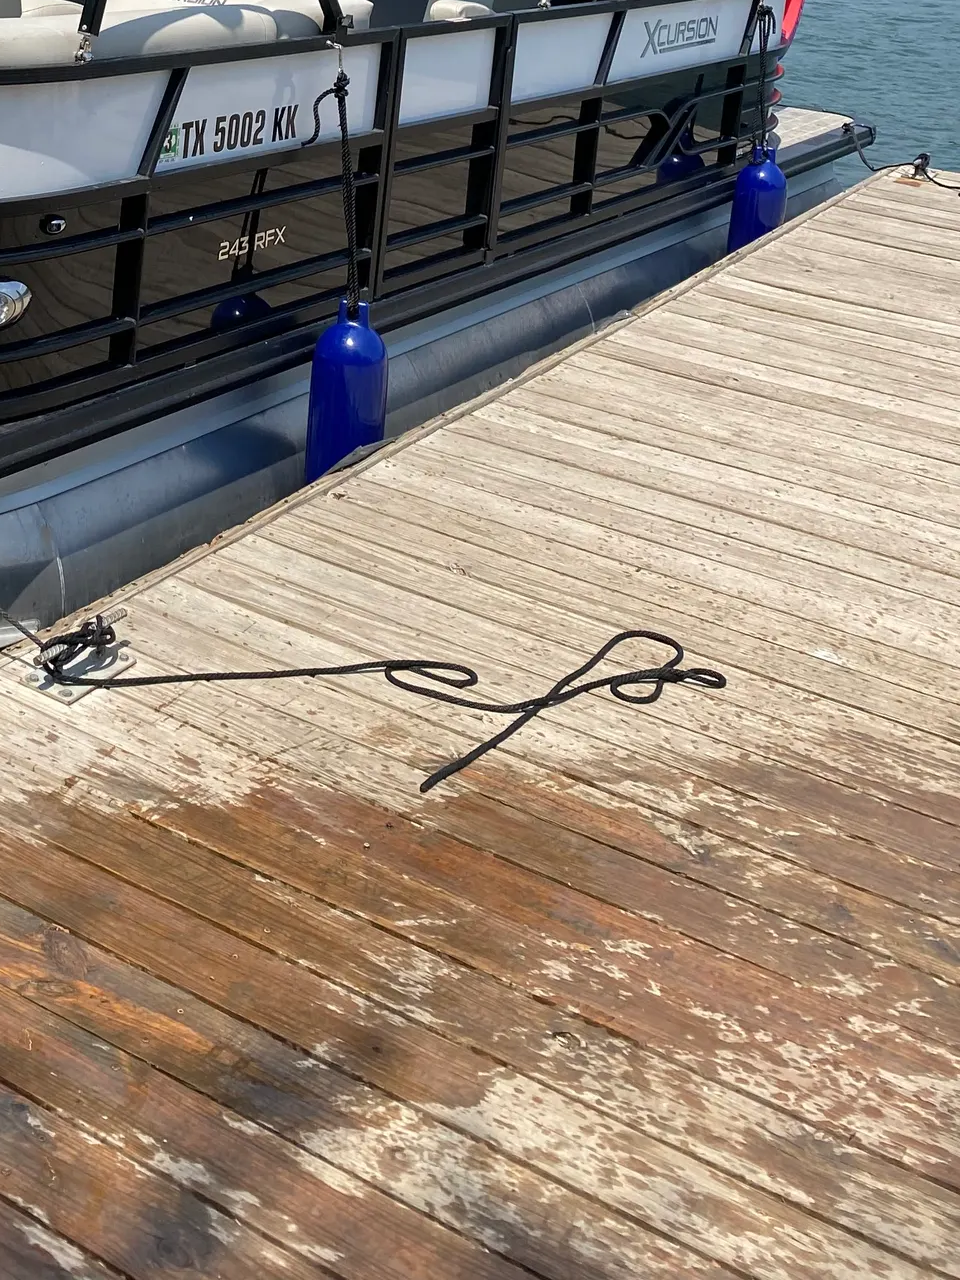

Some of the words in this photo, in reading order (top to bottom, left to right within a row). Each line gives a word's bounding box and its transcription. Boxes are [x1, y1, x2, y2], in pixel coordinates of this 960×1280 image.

[640, 15, 719, 59] XCURSION
[181, 118, 208, 160] TX
[213, 109, 267, 153] 5002
[271, 104, 300, 143] KK
[218, 235, 250, 261] 243
[253, 225, 287, 251] RFX
